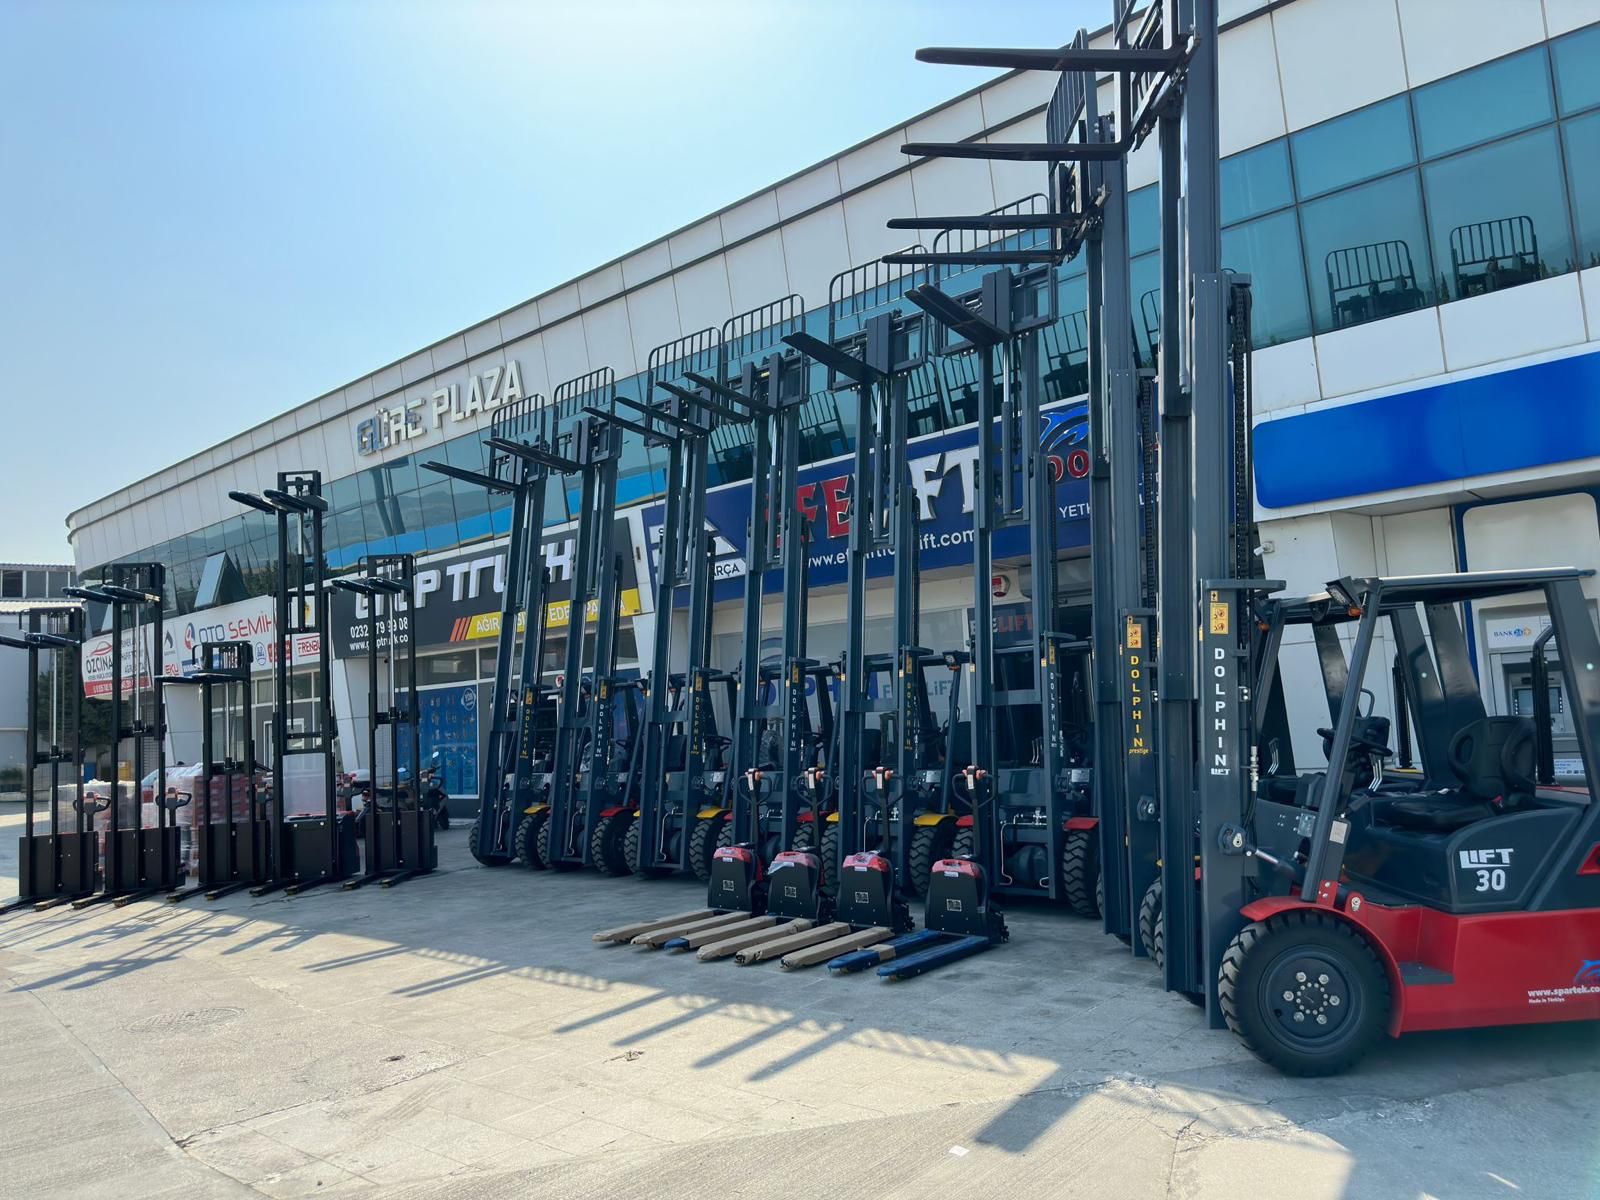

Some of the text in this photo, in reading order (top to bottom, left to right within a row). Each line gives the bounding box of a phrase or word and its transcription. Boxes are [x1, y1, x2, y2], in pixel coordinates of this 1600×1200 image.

[431, 359, 525, 430] PLAZA
[199, 624, 225, 643] OTO
[350, 624, 369, 639] 0232
[398, 616, 408, 631] 08
[1049, 672, 1057, 742] DOLPHIN
[1130, 655, 1144, 747] DOLPHIN
[1213, 647, 1227, 767] DOLPHIN
[596, 703, 605, 754] DOLPHIN
[1128, 747, 1149, 755] prestige
[1459, 848, 1514, 869] LIFT
[1475, 869, 1506, 892] 30
